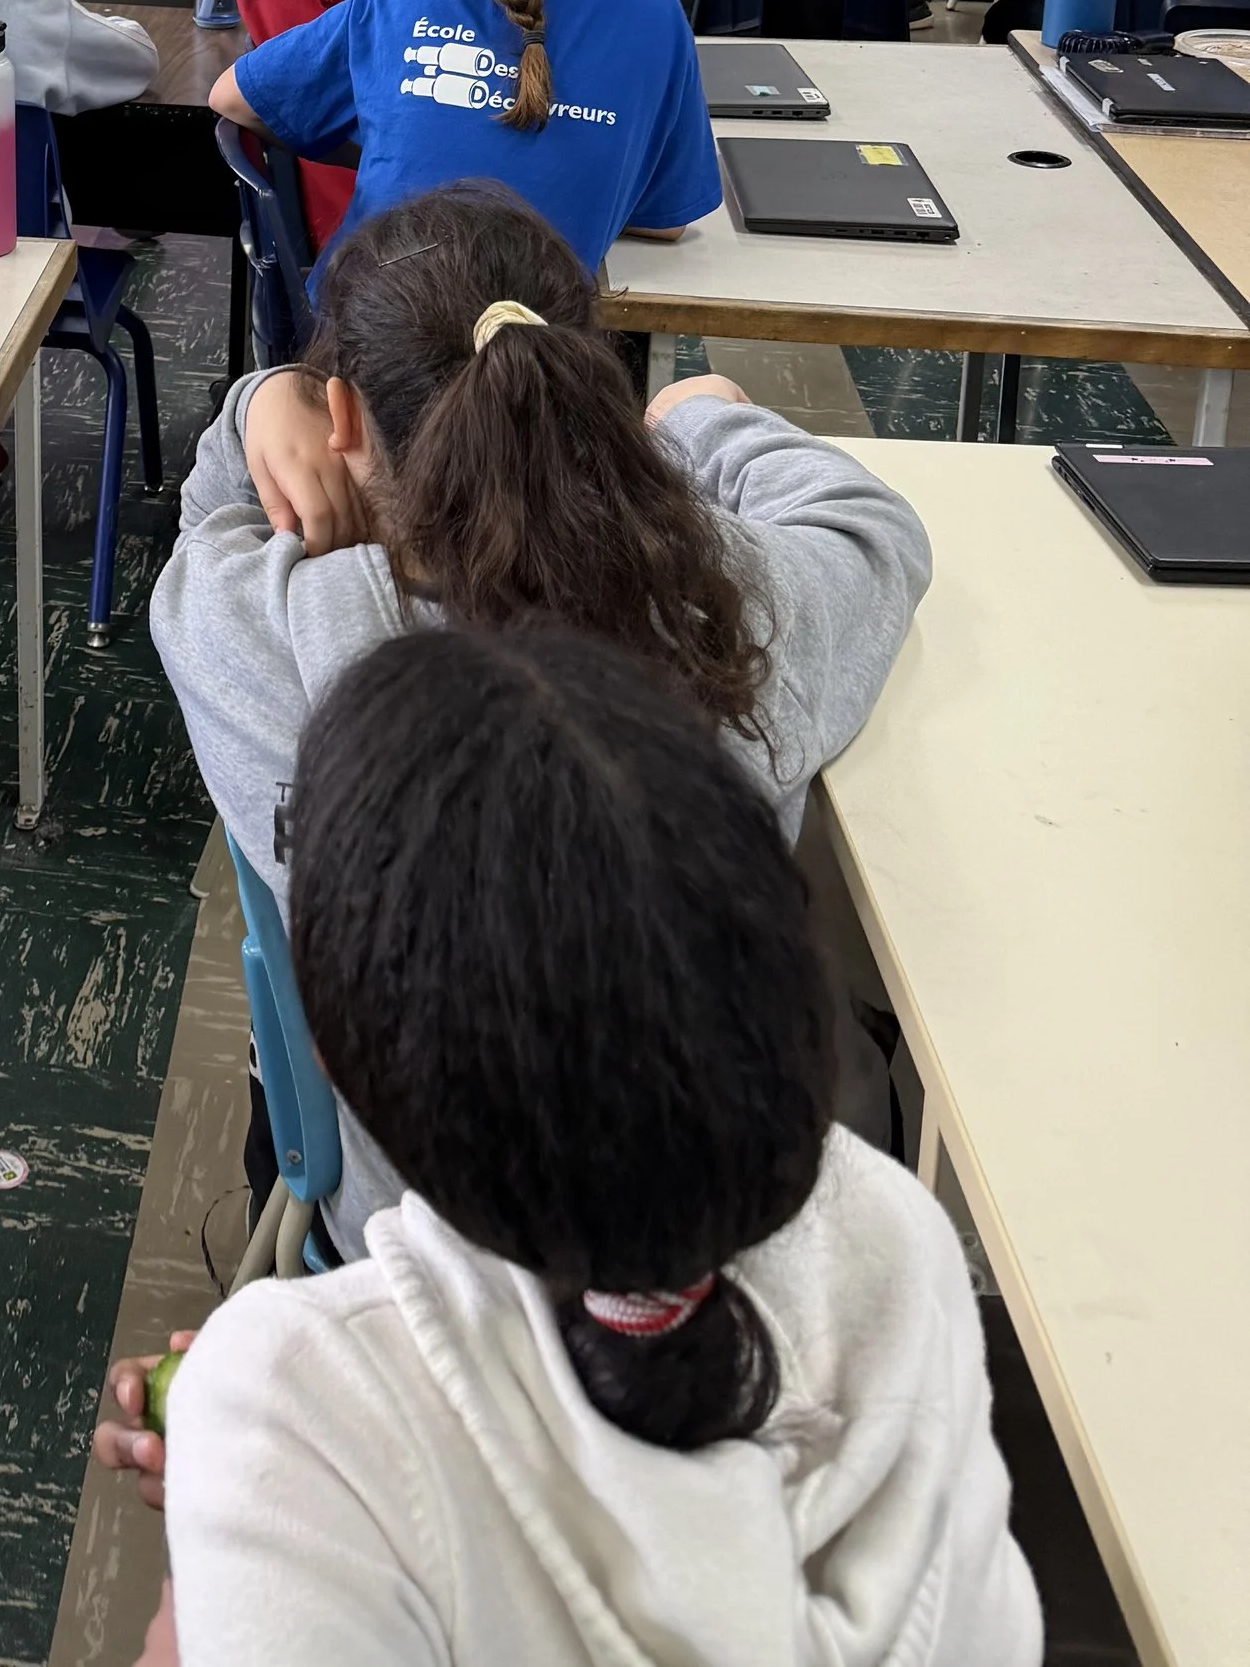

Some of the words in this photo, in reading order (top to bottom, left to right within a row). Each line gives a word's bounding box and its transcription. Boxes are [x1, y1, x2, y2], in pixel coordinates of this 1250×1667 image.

[412, 17, 475, 42] École
[476, 53, 519, 79] Des
[470, 85, 617, 125] Décvreurs
